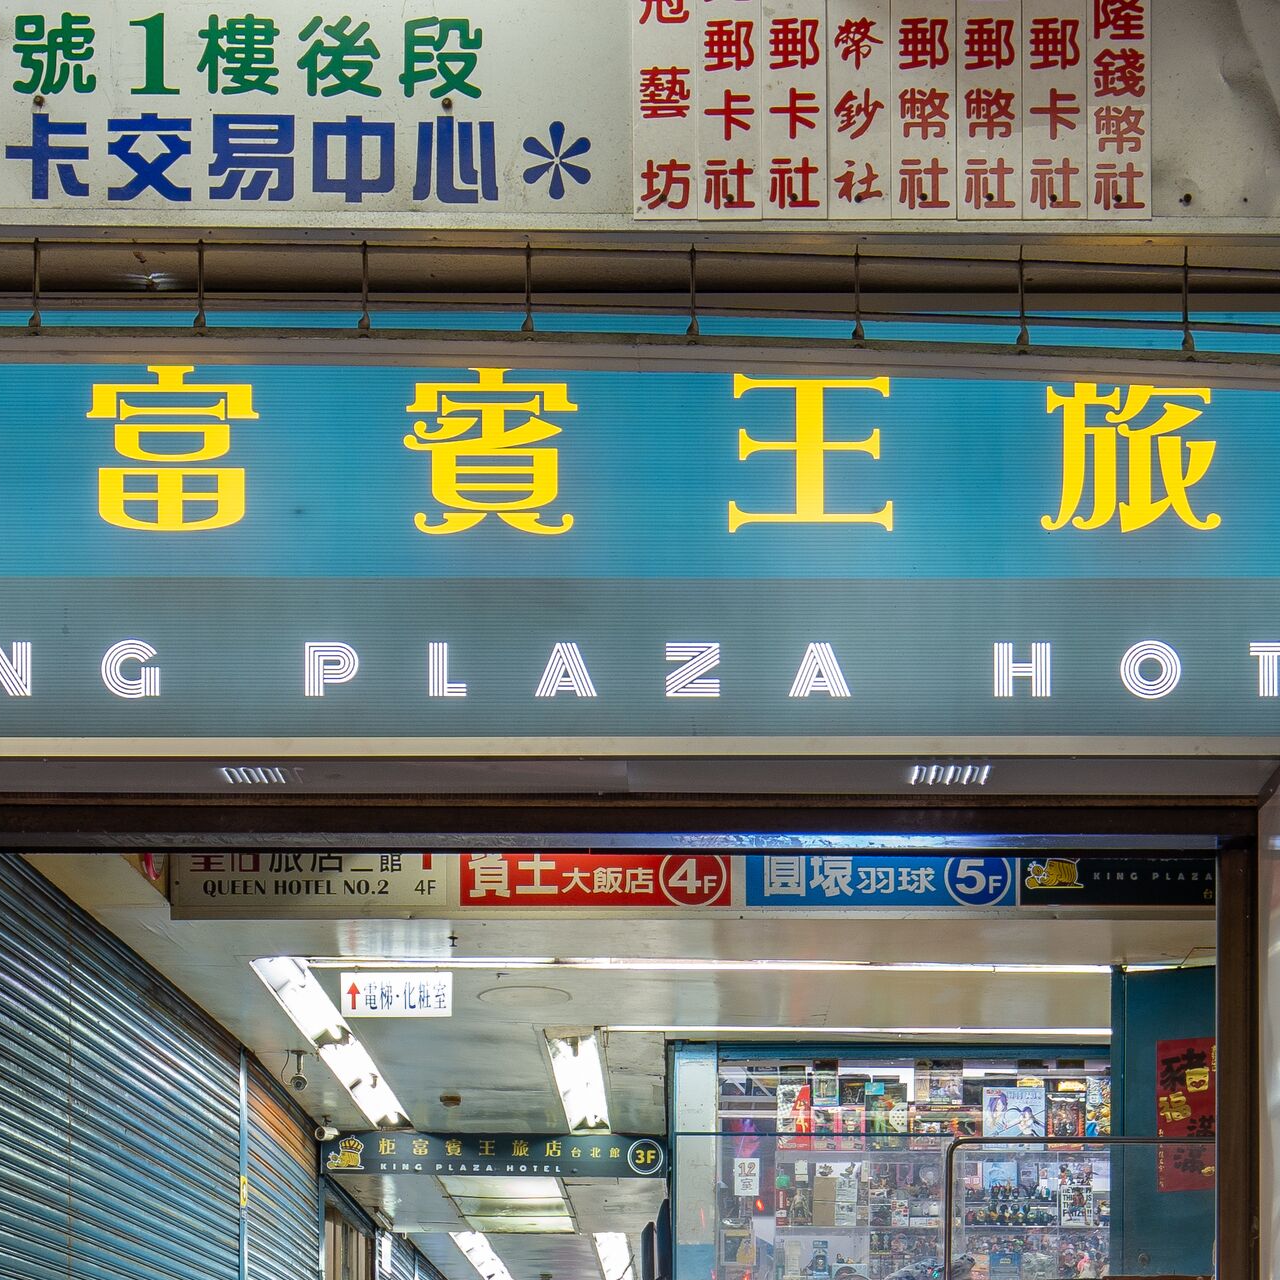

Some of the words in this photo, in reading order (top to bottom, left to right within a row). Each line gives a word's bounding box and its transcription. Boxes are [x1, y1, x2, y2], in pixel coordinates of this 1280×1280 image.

[704, 0, 755, 209] 郵卡社
[769, 17, 819, 209] 郵卡社
[833, 17, 883, 202] 幣鈔社
[898, 17, 950, 209] 郵幣社
[965, 17, 1015, 209] 郵幣社
[1030, 17, 1081, 209] 郵卡社
[1094, 0, 1146, 209] 隆錢幣社
[305, 641, 851, 698] PLAZA
[203, 879, 266, 896] QUEEN
[274, 879, 337, 895] HOTEL
[343, 879, 390, 895] NO.2
[414, 880, 437, 895] 4F
[668, 858, 717, 895] 4F
[955, 858, 1003, 892] 5F
[1093, 872, 1139, 881] KING
[1152, 872, 1213, 881] PLAZA
[380, 1163, 423, 1172] KING
[435, 1164, 493, 1172] PLAZA
[507, 1164, 562, 1173] HOTEL
[634, 1150, 656, 1165] 3F
